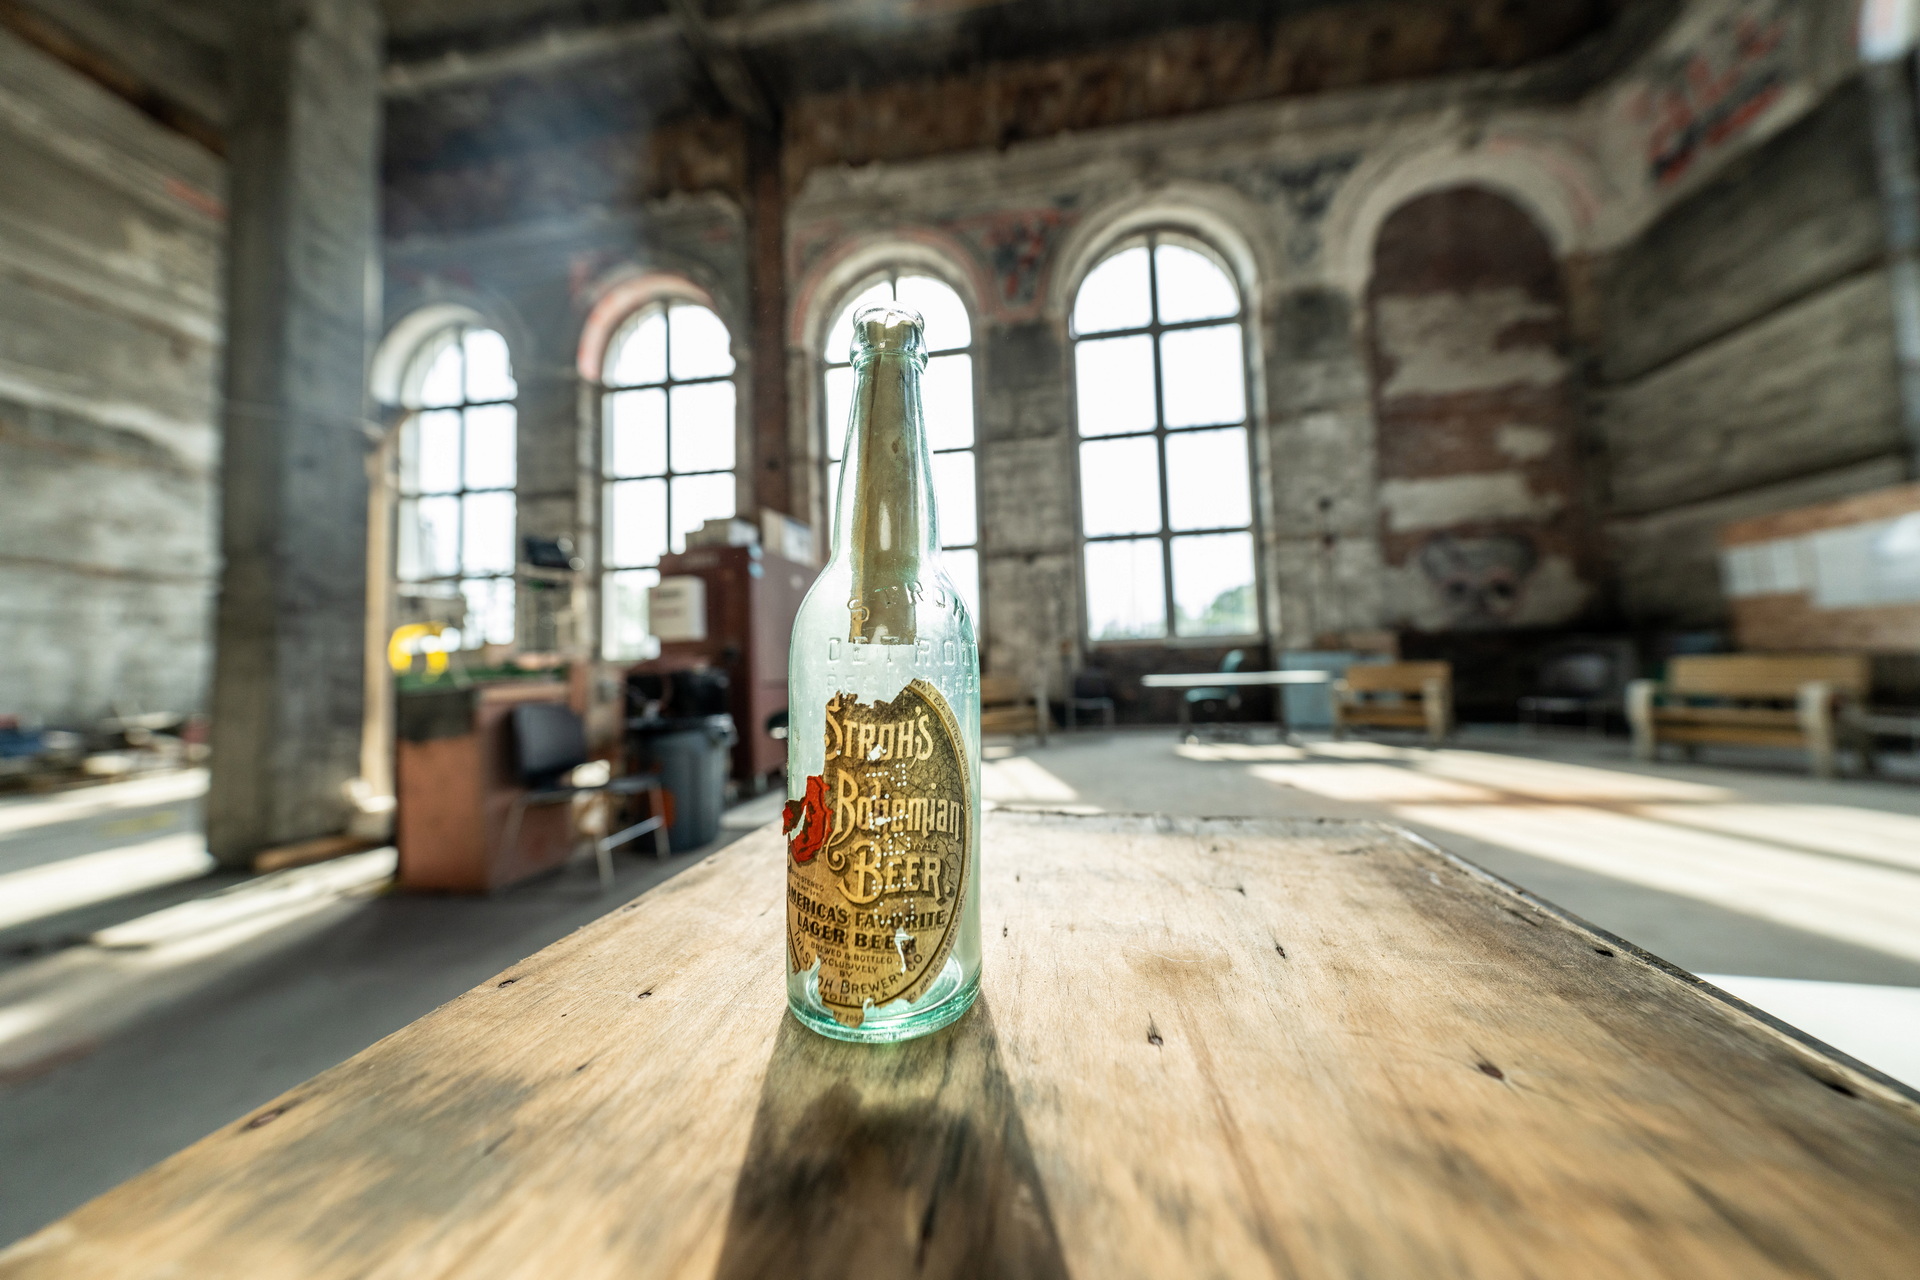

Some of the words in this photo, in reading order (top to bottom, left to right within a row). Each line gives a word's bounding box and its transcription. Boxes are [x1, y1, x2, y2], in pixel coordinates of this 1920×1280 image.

[825, 694, 934, 768] STROH'S
[797, 912, 845, 944] LAGER
[855, 909, 946, 930] FAVORITE
[811, 941, 842, 957] BREWED
[853, 954, 893, 965] BOTTLED
[819, 955, 879, 974] XCLUSIVELY
[839, 970, 853, 978] BY
